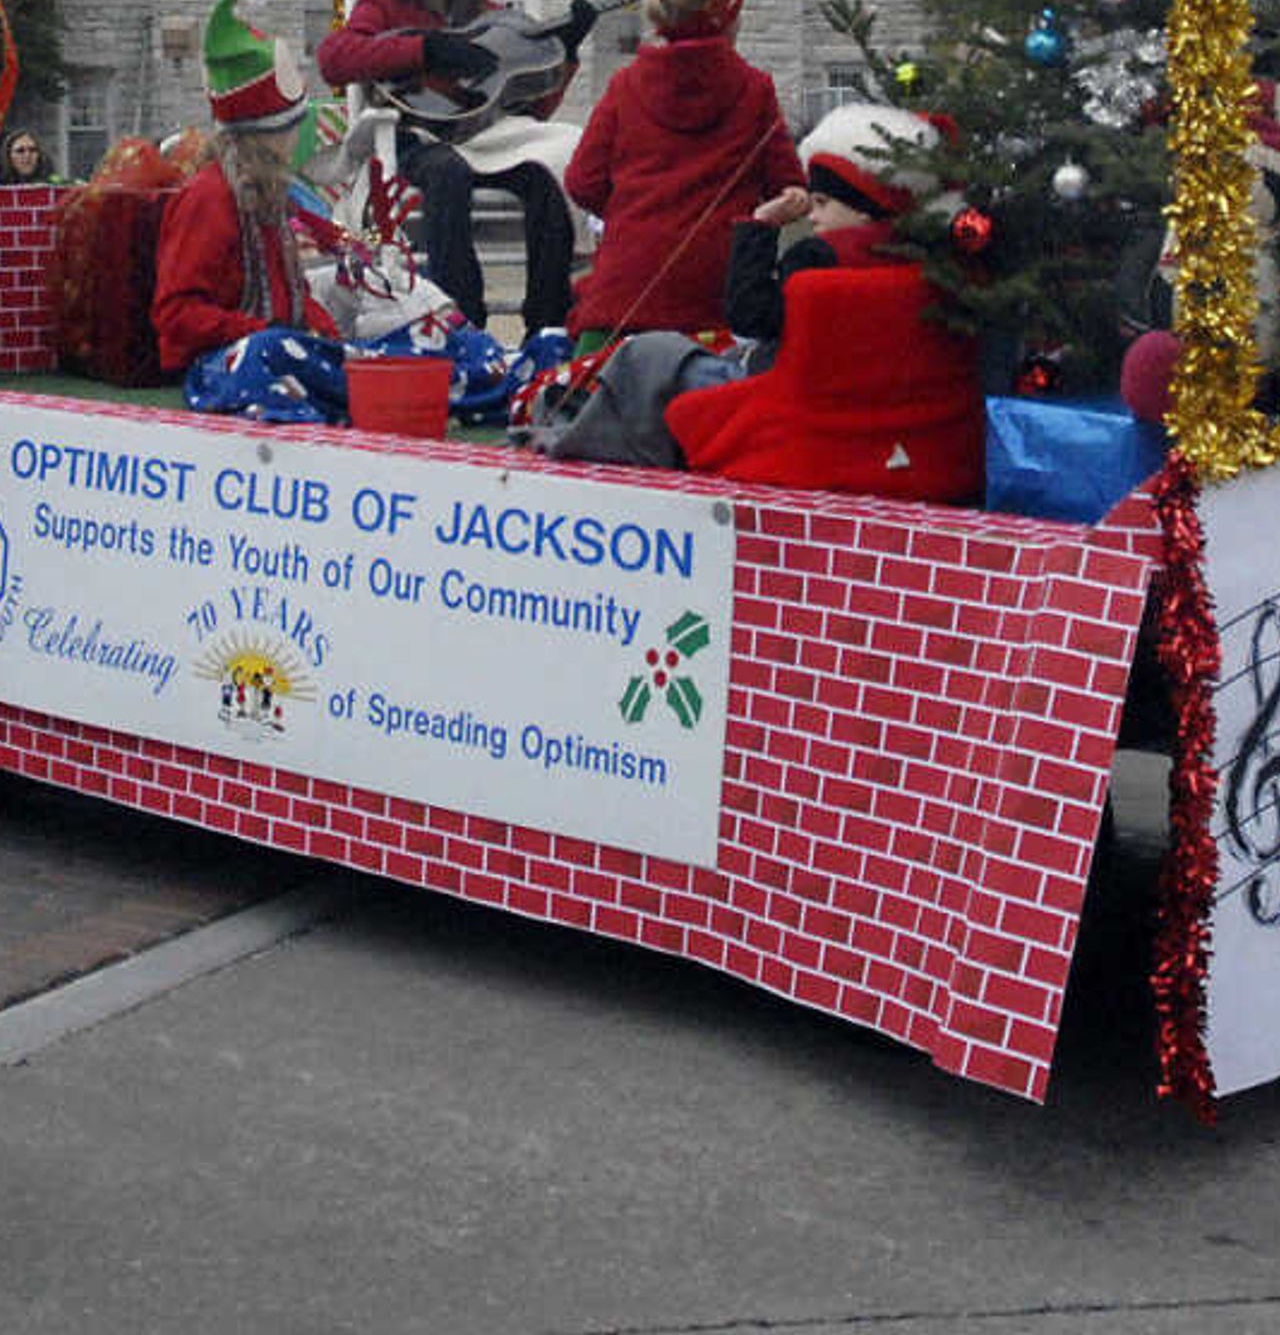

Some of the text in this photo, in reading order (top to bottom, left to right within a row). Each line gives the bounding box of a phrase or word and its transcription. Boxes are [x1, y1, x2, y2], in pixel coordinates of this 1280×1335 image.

[11, 438, 196, 503] OPTIMIST
[215, 468, 329, 524] CLUB
[351, 487, 418, 536] OF
[435, 501, 695, 579] JACKSON
[34, 502, 642, 646] Supports the Youth of Our Community
[23, 606, 180, 696] Celebrating
[185, 585, 332, 667] 70 YEARS
[328, 688, 669, 786] of Spreading Optimism
